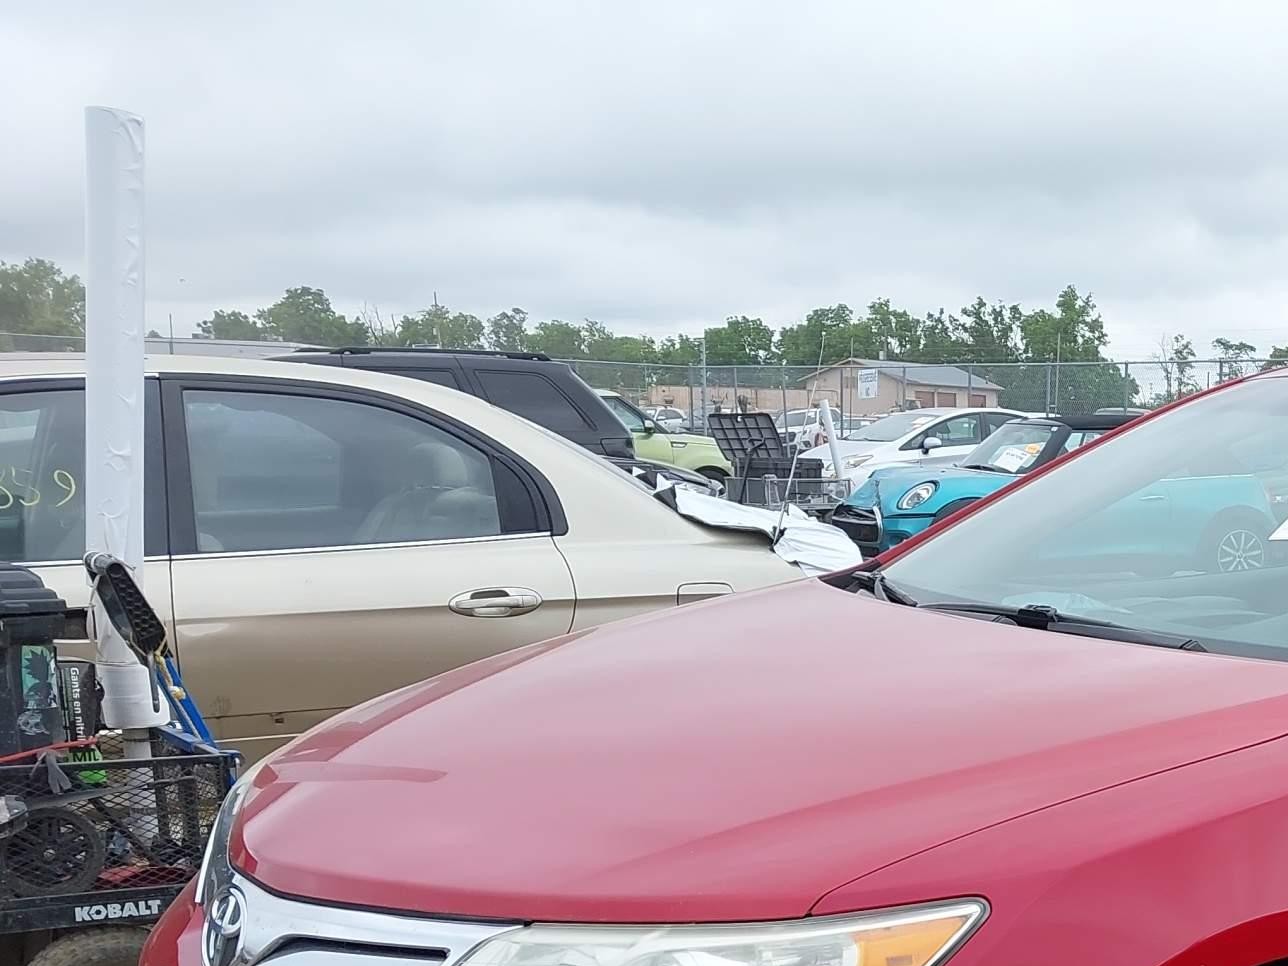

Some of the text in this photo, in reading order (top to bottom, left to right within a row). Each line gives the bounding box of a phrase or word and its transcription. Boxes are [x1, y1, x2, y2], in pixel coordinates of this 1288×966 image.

[70, 667, 80, 699] Gants
[73, 701, 82, 714] en
[74, 900, 161, 922] KOBALT
